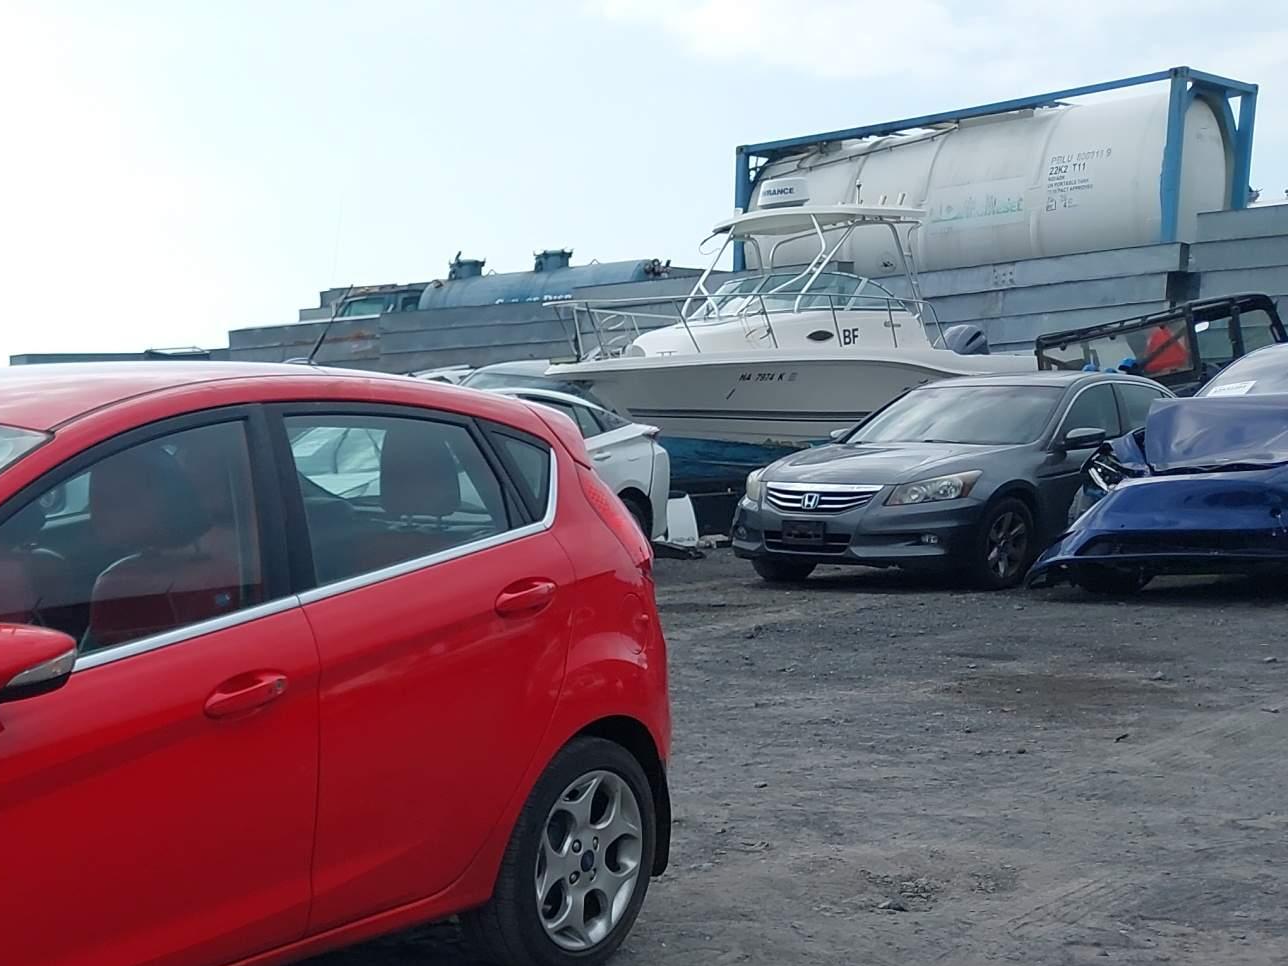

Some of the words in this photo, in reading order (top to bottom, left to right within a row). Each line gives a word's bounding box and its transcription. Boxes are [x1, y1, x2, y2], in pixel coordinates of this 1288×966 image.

[1049, 165, 1069, 175] 22K2
[1073, 162, 1086, 172] T11
[843, 328, 859, 345] BF
